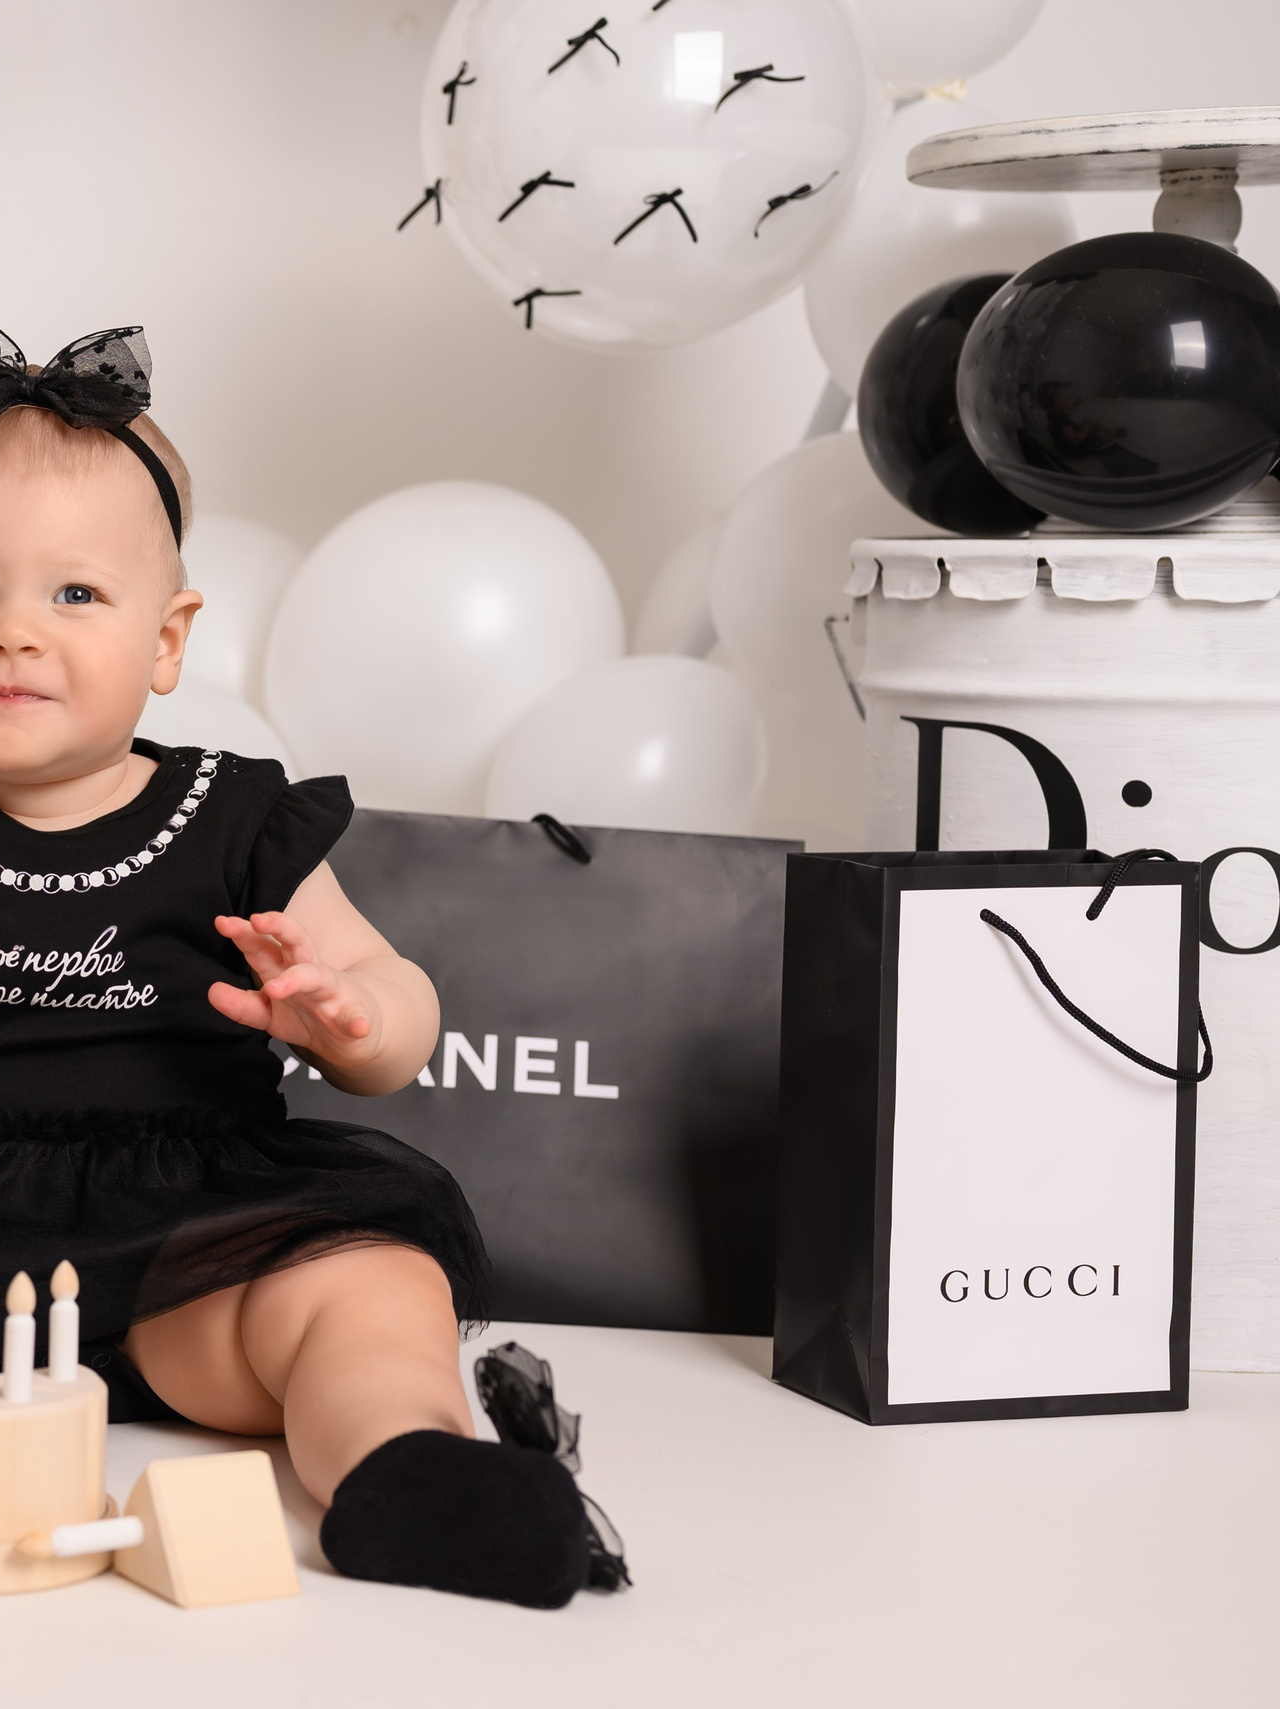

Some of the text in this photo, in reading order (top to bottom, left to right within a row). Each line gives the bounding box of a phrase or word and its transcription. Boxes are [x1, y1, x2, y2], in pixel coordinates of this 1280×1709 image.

[900, 715, 1280, 955] Do
[22, 925, 126, 992] первое
[30, 979, 159, 1011] платье
[282, 1031, 620, 1100] NEL
[940, 1263, 1120, 1303] GUCCI
